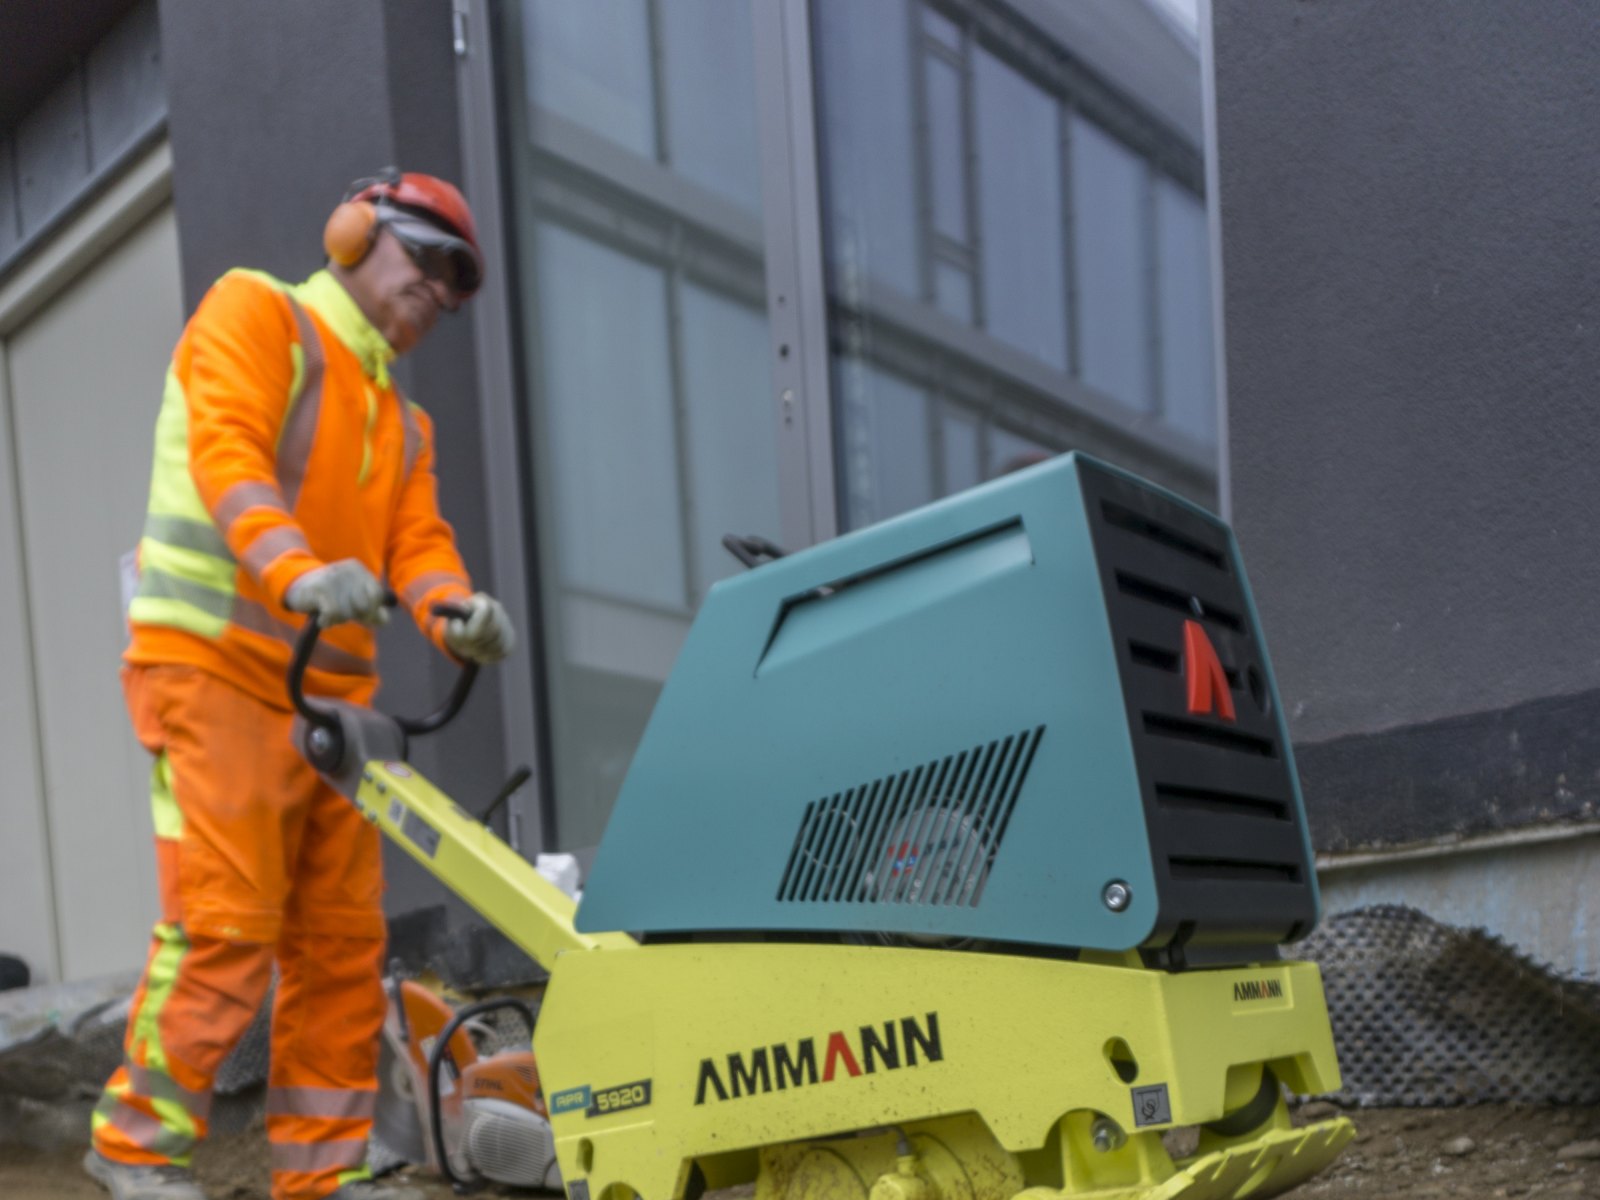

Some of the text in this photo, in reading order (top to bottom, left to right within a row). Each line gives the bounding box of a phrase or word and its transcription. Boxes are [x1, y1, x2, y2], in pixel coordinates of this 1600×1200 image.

[1233, 979, 1283, 1001] AMMANN
[694, 1011, 944, 1106] AMMANN
[555, 1085, 645, 1111] APR 5920
